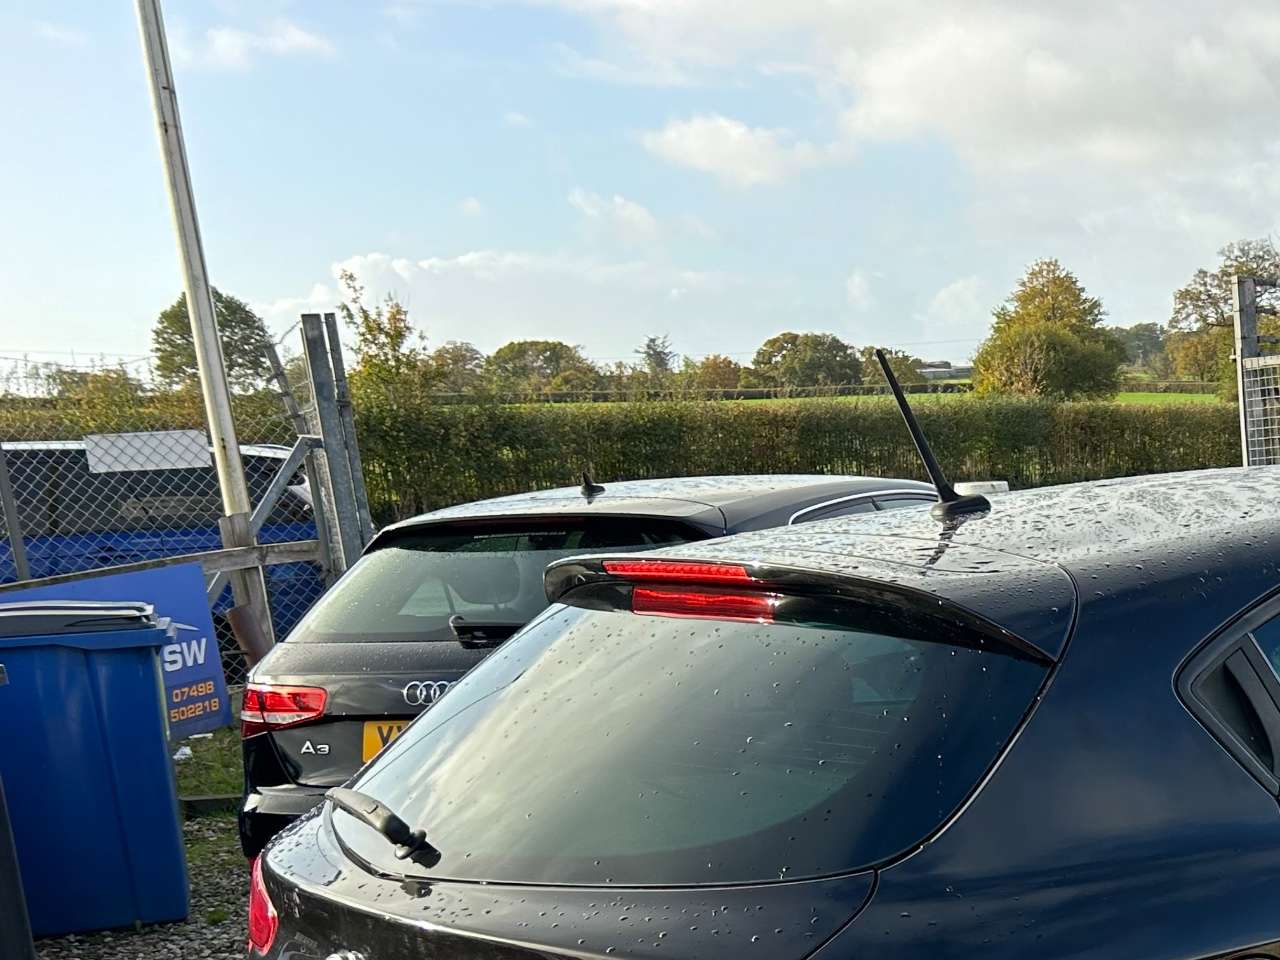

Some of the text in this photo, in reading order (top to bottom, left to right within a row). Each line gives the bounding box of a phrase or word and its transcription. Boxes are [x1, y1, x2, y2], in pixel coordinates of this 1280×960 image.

[172, 681, 214, 703] 07498
[170, 698, 219, 722] 502218
[300, 740, 330, 754] A3
